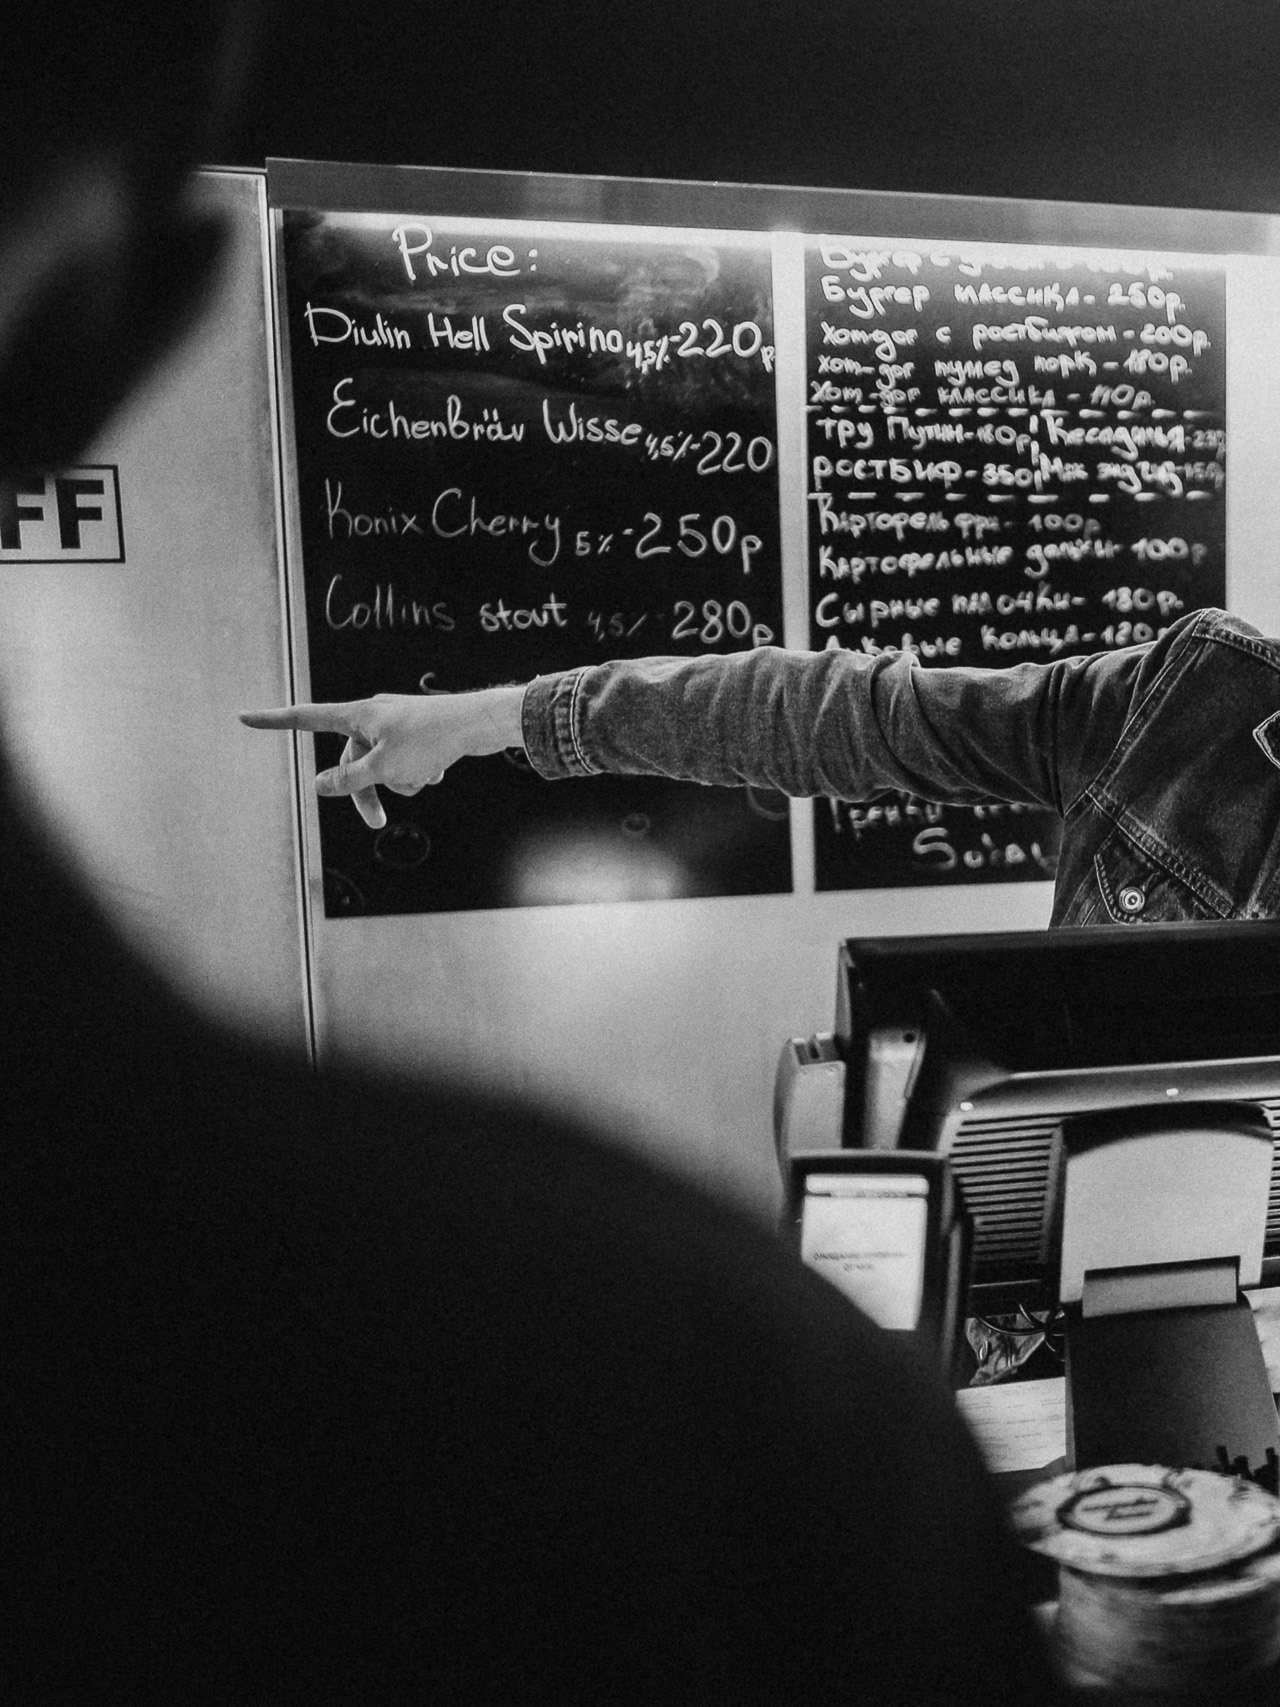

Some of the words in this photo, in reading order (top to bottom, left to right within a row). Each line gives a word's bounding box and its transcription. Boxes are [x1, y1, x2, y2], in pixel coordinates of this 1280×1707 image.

[393, 223, 539, 280] Price:
[820, 275, 930, 319] Бургер
[429, 313, 490, 353] Hell
[503, 304, 624, 364] Spirino
[543, 399, 643, 445] Wisse
[325, 478, 424, 539] Konix
[432, 488, 560, 566] Cherry
[326, 574, 455, 629] Collins
[480, 593, 568, 631] stout
[816, 592, 940, 628] Сырные
